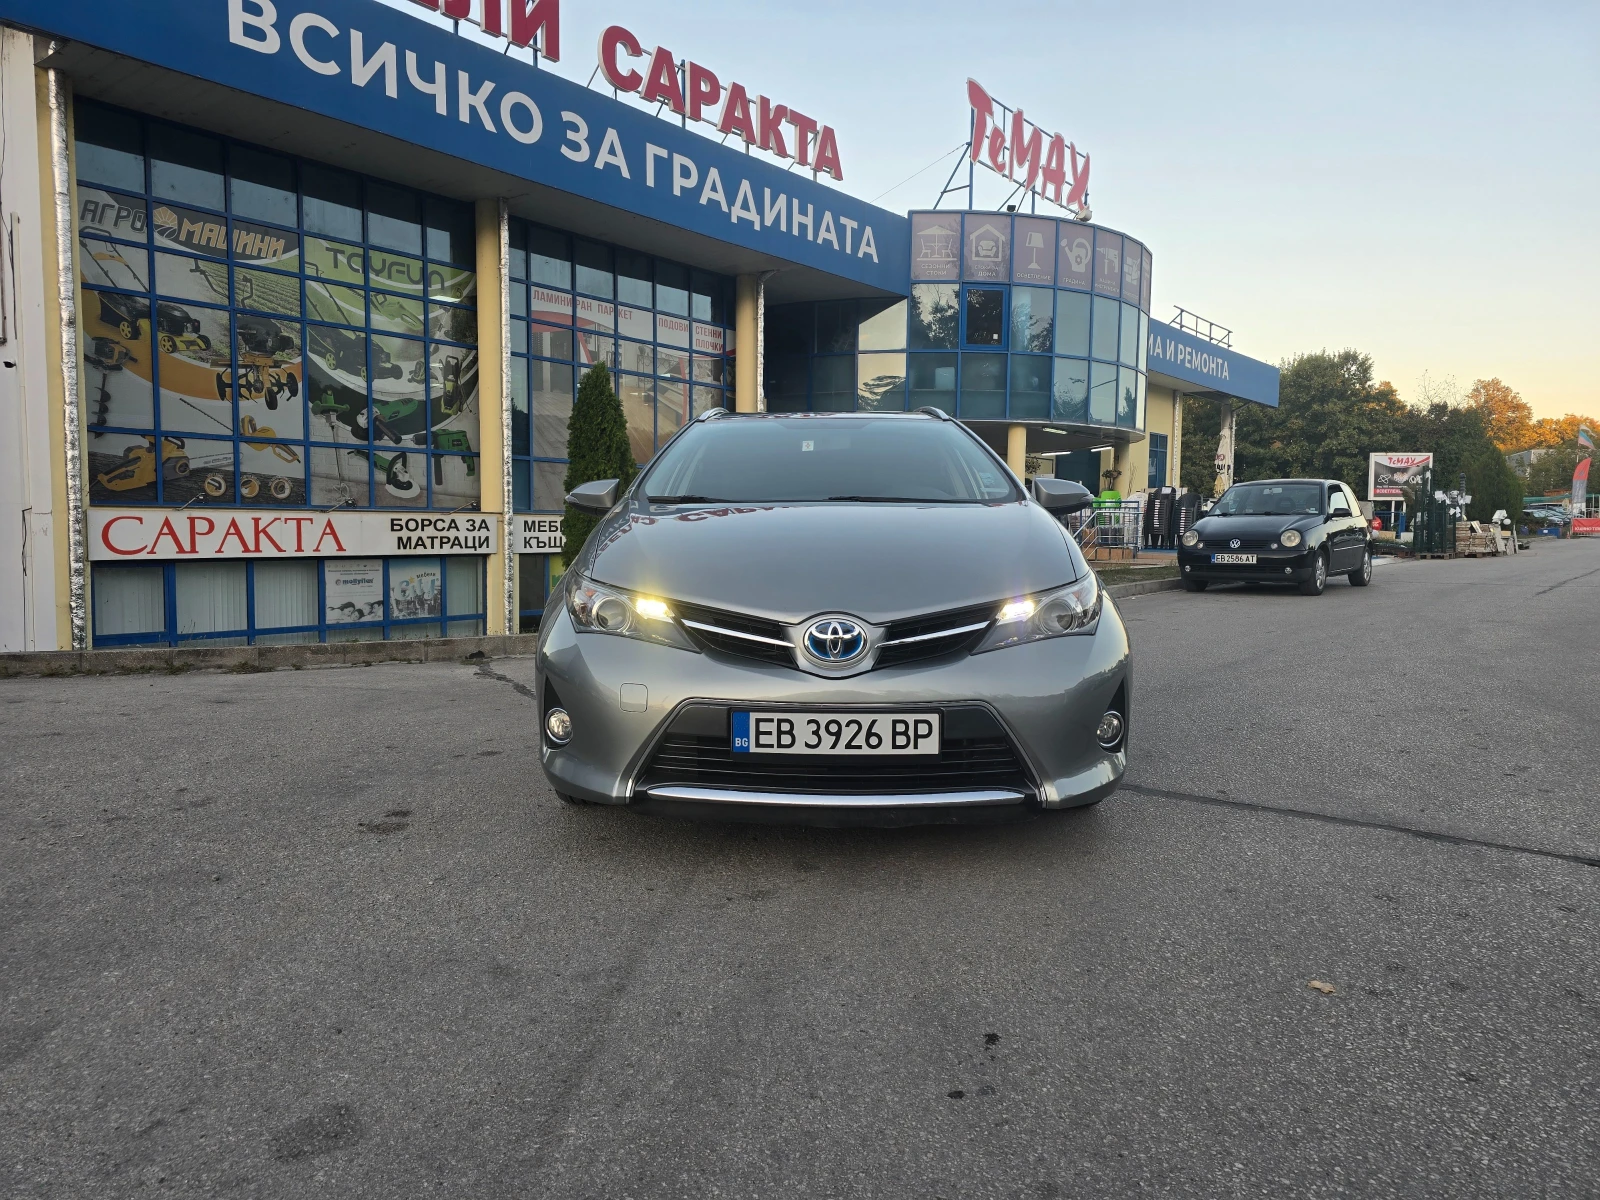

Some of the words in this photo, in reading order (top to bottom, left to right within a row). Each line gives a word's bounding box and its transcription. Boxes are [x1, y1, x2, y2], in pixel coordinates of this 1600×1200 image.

[597, 25, 843, 181] САРАКТА
[228, 0, 543, 144] ВСИЧКО
[560, 110, 631, 180] ЗА
[645, 142, 879, 263] ГРАДИНАТА
[80, 199, 148, 233] АГРО
[178, 217, 286, 260] МАШИНИ
[658, 317, 688, 333] ПОДОВИ
[695, 325, 722, 340] СТЕННИ
[695, 338, 724, 352] ПЛОЧКИ
[1166, 338, 1175, 361] И
[1178, 343, 1229, 380] РЕМОНТА
[101, 515, 346, 555] САРАКТА
[390, 518, 461, 533] БОРСА
[466, 518, 491, 533] ЗА
[397, 535, 491, 554] МАТРАЦИ
[1216, 555, 1226, 563] EB
[1226, 555, 1244, 563] 2586
[1245, 555, 1255, 563] AT
[735, 738, 749, 747] BG
[754, 717, 797, 749] EB
[804, 718, 883, 750] 3926
[891, 719, 934, 750] BP
